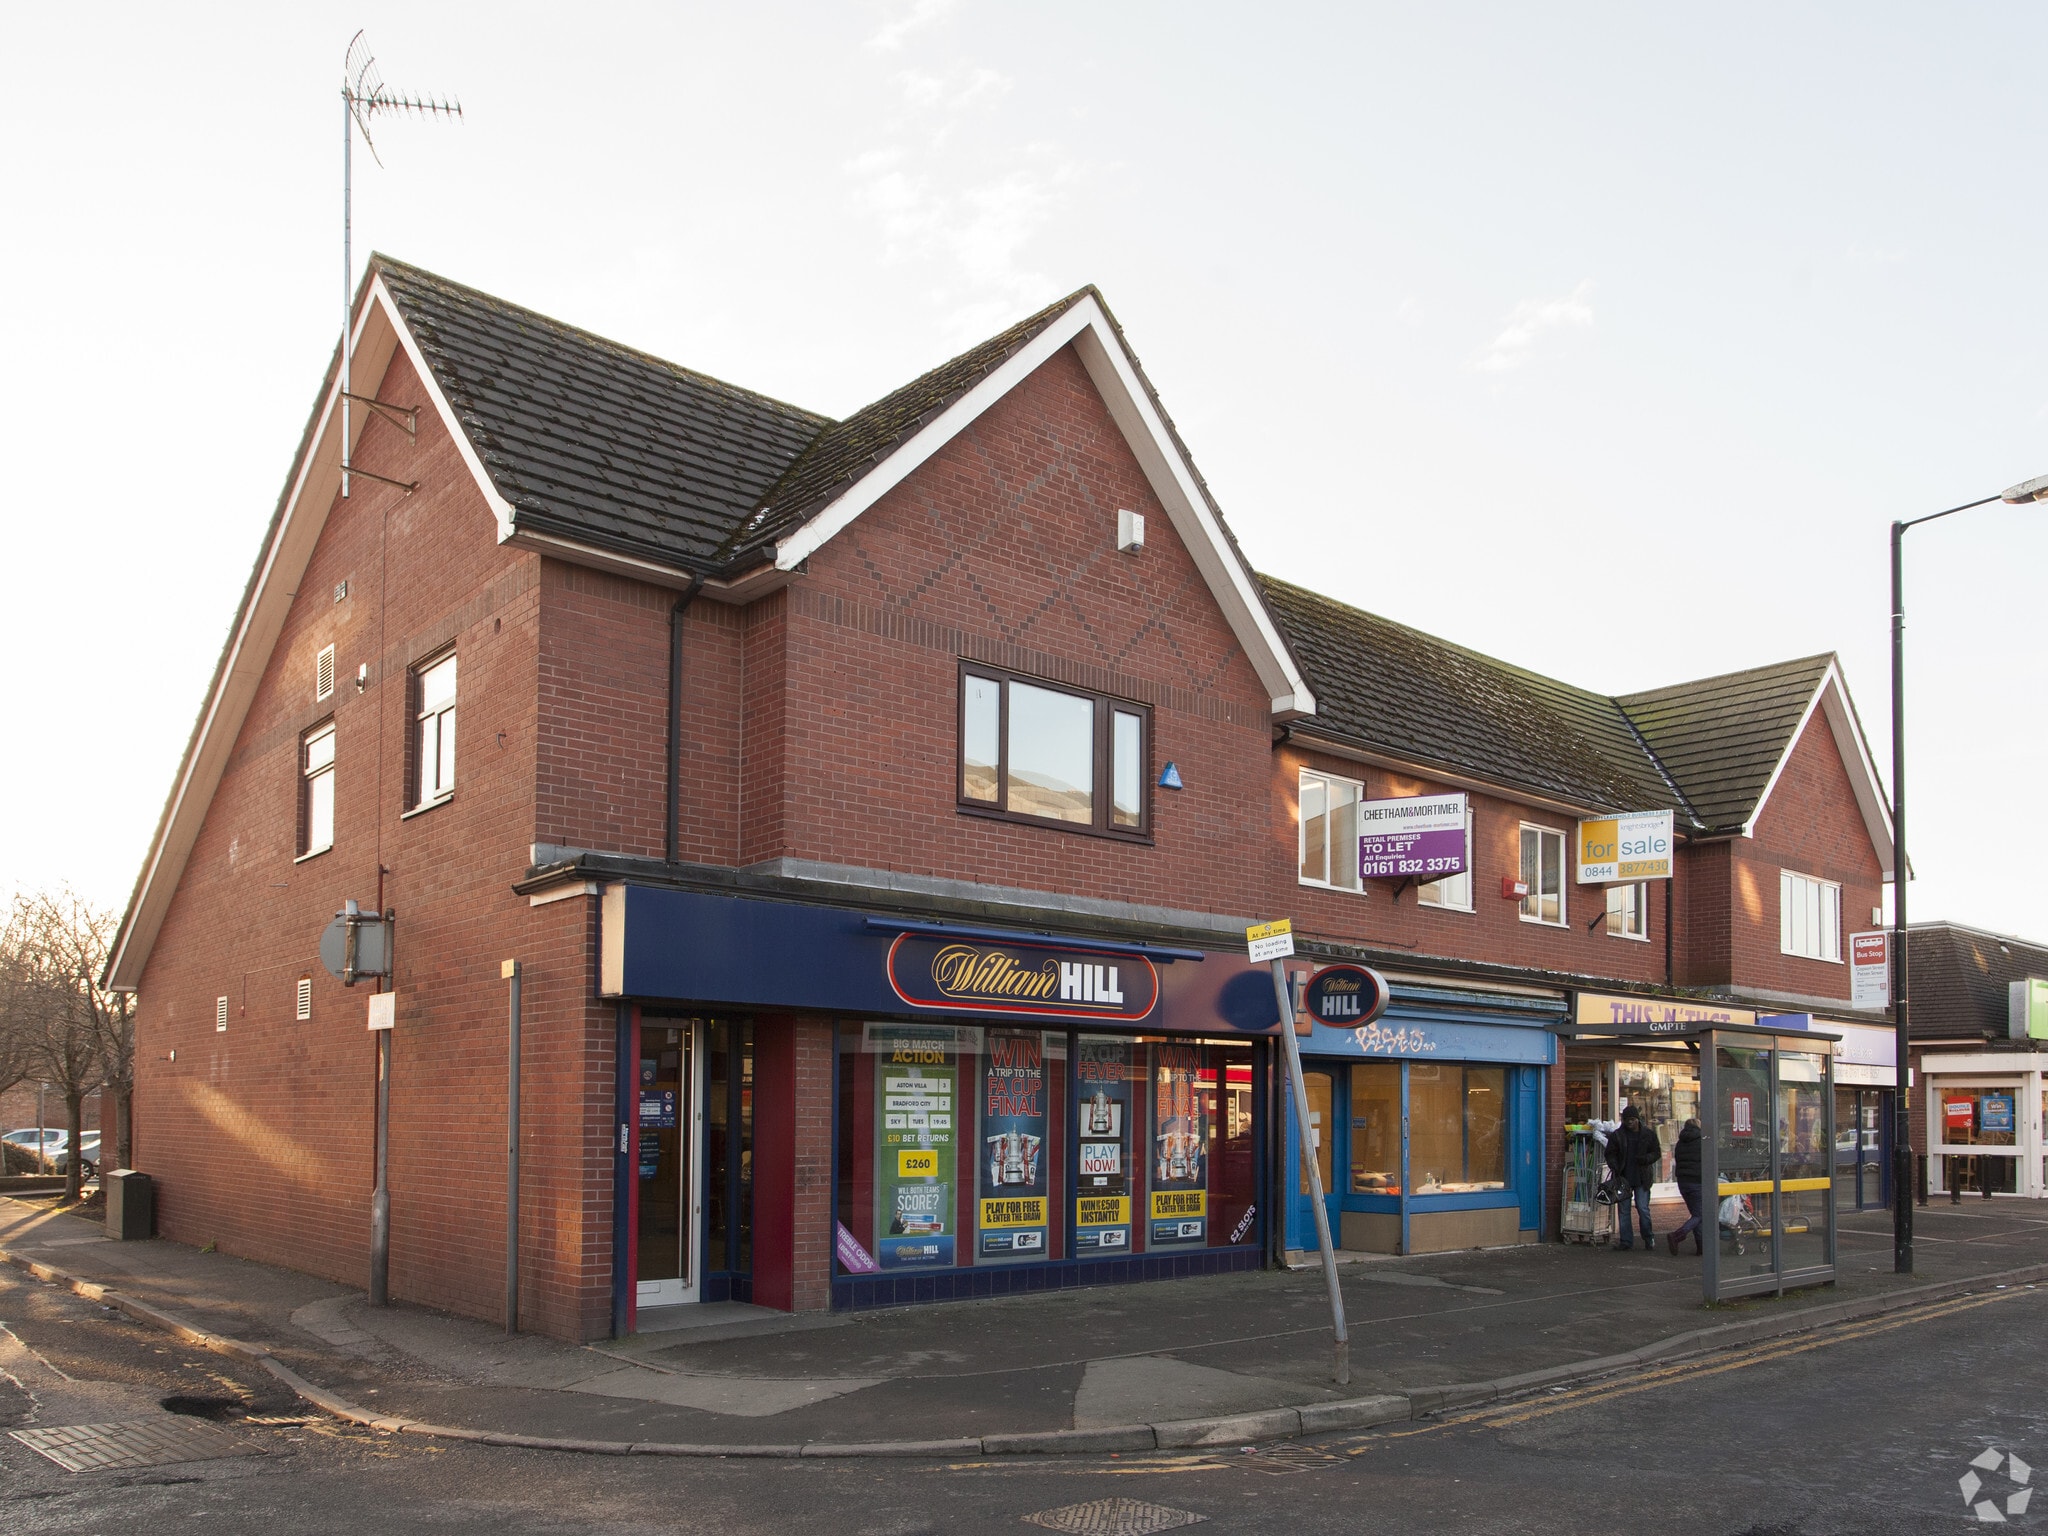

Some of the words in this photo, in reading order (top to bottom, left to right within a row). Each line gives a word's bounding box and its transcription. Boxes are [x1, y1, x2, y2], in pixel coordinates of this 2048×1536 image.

[1364, 836, 1386, 844] RETAIL
[1387, 834, 1421, 842] PREMISES
[1364, 844, 1383, 854] TO
[1388, 842, 1414, 852] LET
[1586, 841, 1614, 858] for
[1622, 836, 1666, 855] sale
[1375, 853, 1406, 861] Enquiries
[1363, 861, 1394, 875] 0161
[1398, 859, 1423, 872] 832
[1426, 856, 1460, 871] 3375
[1585, 866, 1612, 877] 0844
[1620, 860, 1668, 874] 3877430
[1266, 940, 1287, 948] loading
[931, 944, 1060, 999] William
[1060, 961, 1124, 1004] HILL
[1322, 977, 1361, 994] William
[1322, 994, 1360, 1016] HILL
[1610, 1002, 1653, 1024] THIS
[1649, 1022, 1687, 1032] GMPTE
[893, 1038, 910, 1048] BIG
[912, 1040, 944, 1050] MATCH
[892, 1049, 944, 1064] ACTION
[988, 1038, 1042, 1068] WIN
[1079, 1046, 1096, 1062] FA
[1098, 1046, 1124, 1062] CUP
[1158, 1046, 1201, 1074] WIN
[988, 1068, 994, 1076] A
[996, 1068, 1012, 1077] TRIP
[1014, 1068, 1024, 1078] TO
[1026, 1069, 1041, 1078] THE
[1078, 1062, 1126, 1080] FEVER
[1188, 1074, 1201, 1082] THE
[988, 1077, 1008, 1095] FA
[1011, 1078, 1042, 1096] CUP
[1158, 1082, 1172, 1098] FA
[988, 1096, 1042, 1117] FINAL
[1158, 1098, 1201, 1117] FINAL
[888, 1134, 900, 1142] £10
[917, 1134, 949, 1142] RETURNS
[1085, 1146, 1116, 1159] PLAY
[906, 1158, 930, 1168] £260
[1085, 1159, 1115, 1172] NOW!
[898, 1194, 939, 1210] SCORE?
[1080, 1200, 1096, 1211] WIN
[1101, 1199, 1119, 1210] £500
[1156, 1195, 1171, 1205] PLAY
[1173, 1194, 1185, 1204] FOR
[1186, 1194, 1200, 1204] FREE
[986, 1202, 1004, 1214] PLAY
[1006, 1202, 1021, 1212] FOR
[1023, 1201, 1040, 1212] FREE
[986, 1214, 992, 1223] &
[993, 1214, 1010, 1222] ENTER
[1012, 1213, 1022, 1221] THE
[1024, 1213, 1040, 1221] DRAW
[1080, 1210, 1119, 1223] INSTANTLY
[1230, 1230, 1239, 1243] £2
[1238, 1205, 1256, 1231] SLOTS
[838, 1228, 858, 1251] TREBLE
[923, 1245, 939, 1254] HILL
